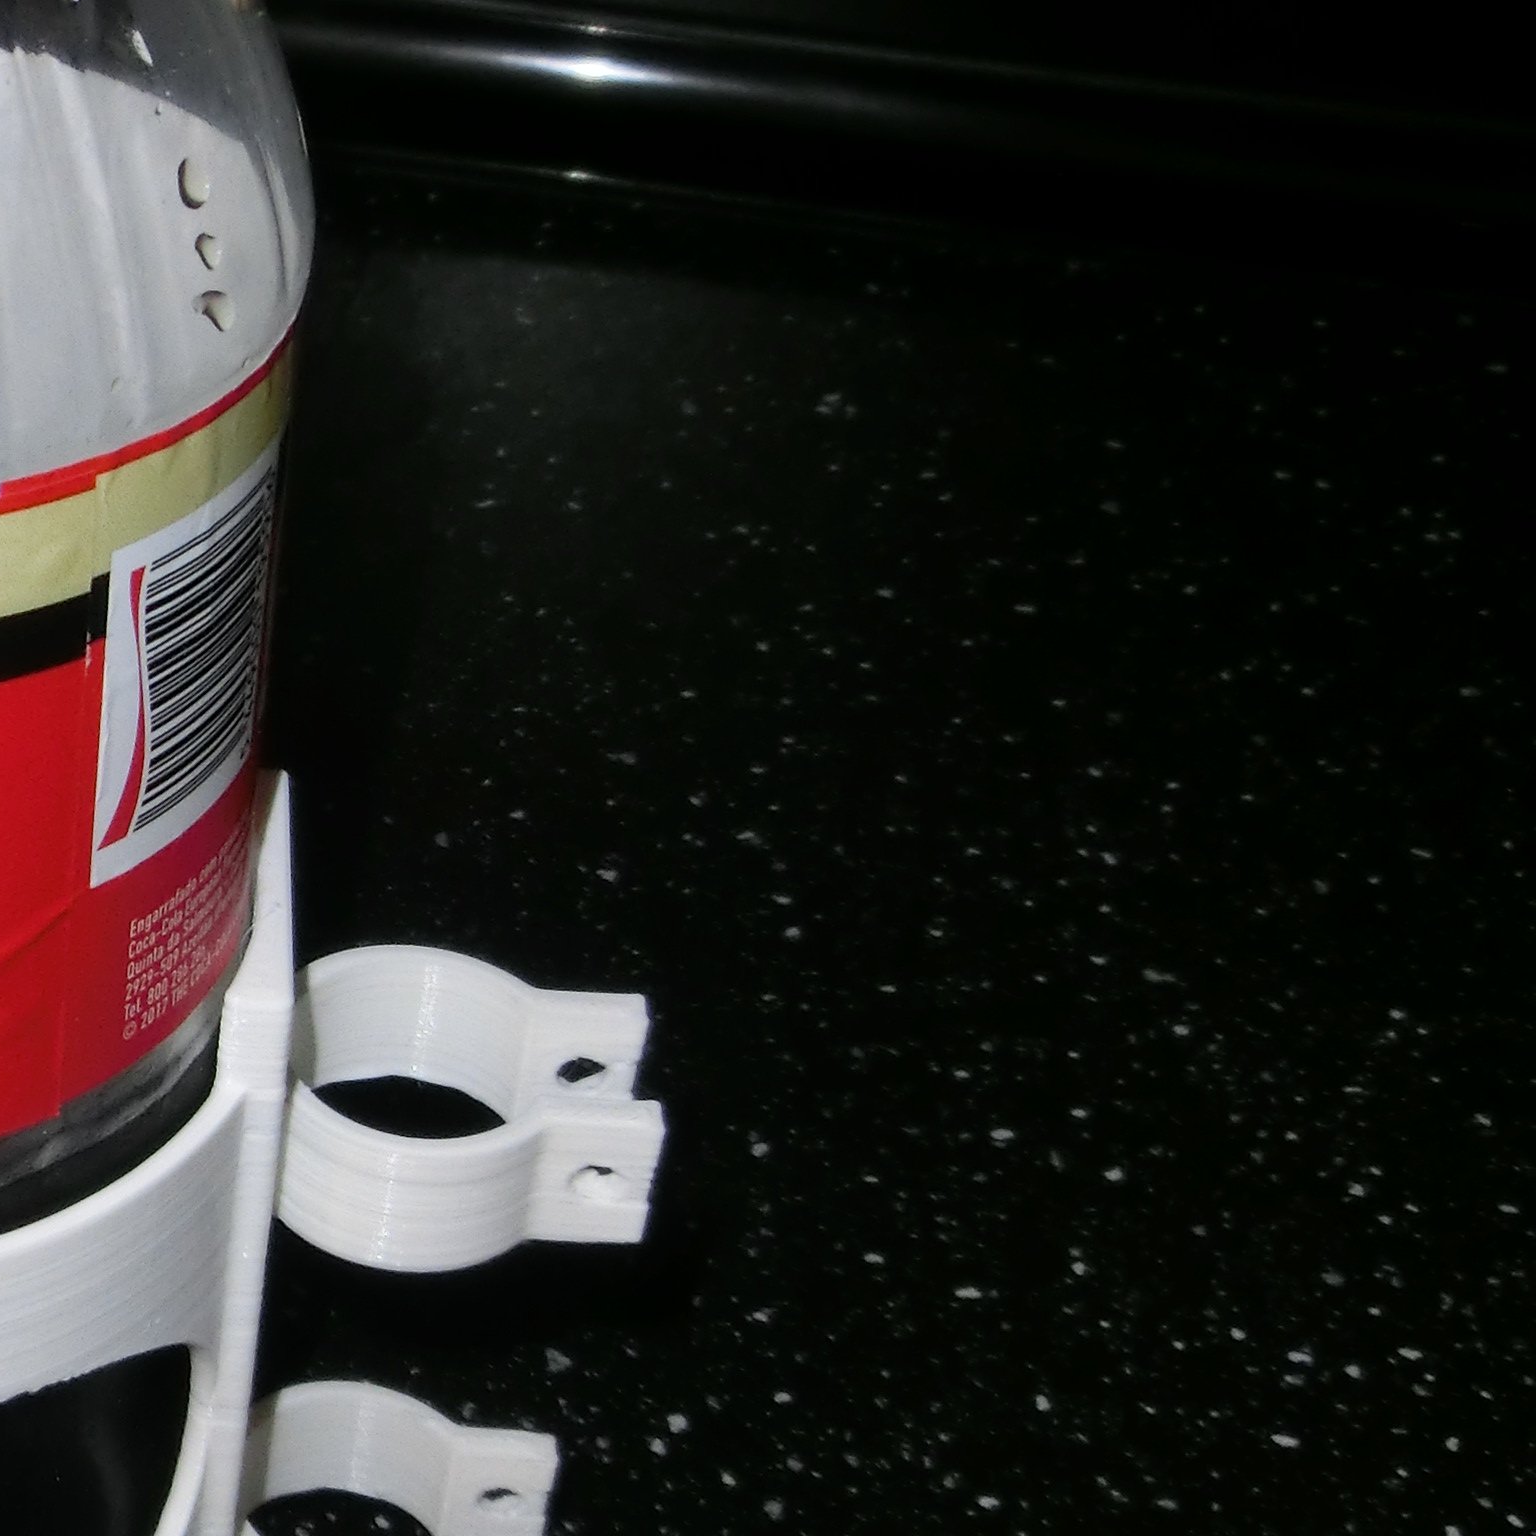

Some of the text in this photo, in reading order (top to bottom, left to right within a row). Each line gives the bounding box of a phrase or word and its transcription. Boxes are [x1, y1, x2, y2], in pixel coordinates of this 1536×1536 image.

[128, 910, 183, 959] Coca-Cola
[127, 945, 163, 980] Quinta
[147, 977, 169, 1005] 800
[141, 997, 169, 1029] 2017
